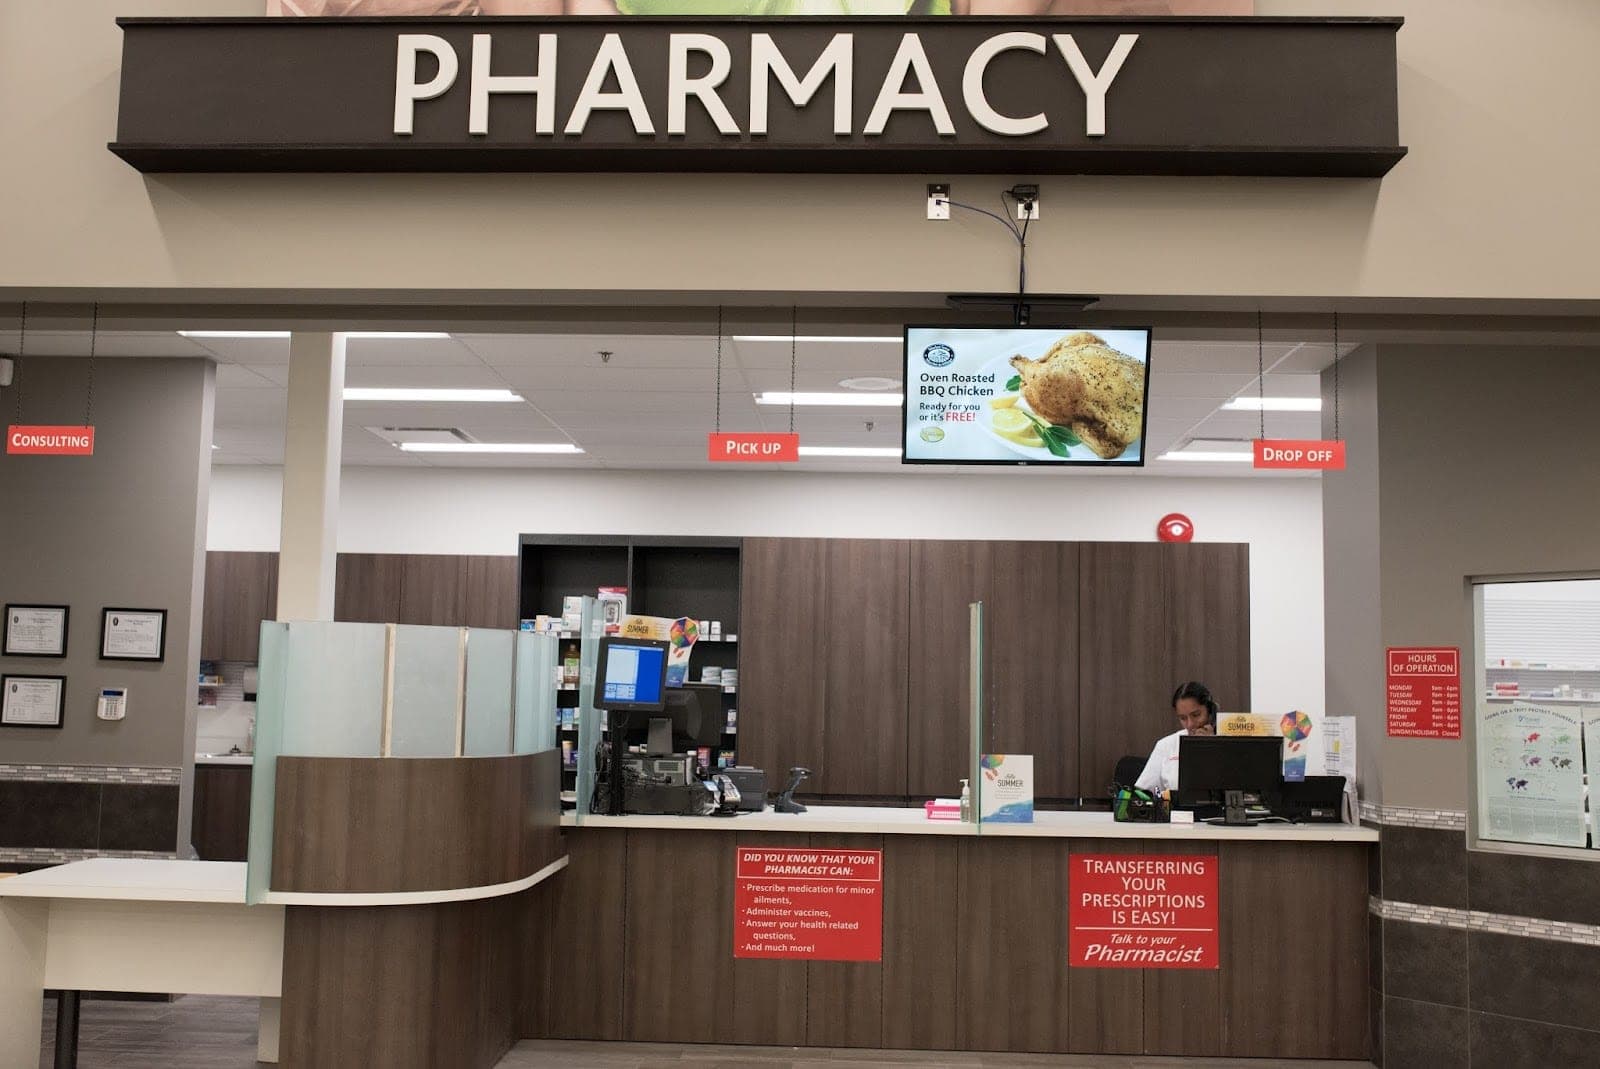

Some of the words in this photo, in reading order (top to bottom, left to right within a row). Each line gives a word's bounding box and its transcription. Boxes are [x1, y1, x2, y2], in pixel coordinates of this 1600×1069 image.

[393, 32, 1140, 136] PHARMACY
[920, 373, 948, 382] Oven
[951, 372, 995, 383] Roasted
[920, 385, 945, 397] BBQ
[948, 385, 994, 396] Chicken
[919, 402, 946, 412] Ready
[948, 402, 961, 410] for
[964, 403, 980, 412] you
[930, 413, 944, 421] it's
[945, 412, 976, 421] FREE!
[12, 433, 89, 447] CONSULTING
[726, 440, 758, 454] PICK
[762, 442, 781, 454] UP
[1263, 447, 1303, 461] DROP
[1307, 450, 1333, 462] OFF
[627, 624, 648, 635] SUMMER
[1408, 654, 1437, 663] HOURS
[1393, 664, 1404, 672] OF
[1406, 664, 1453, 673] OPERATION
[1227, 722, 1255, 731] SUMMER
[997, 779, 1024, 787] SUMMER
[743, 853, 761, 862] DID
[764, 853, 784, 862] YOU
[786, 854, 817, 863] KNOW
[820, 854, 846, 864] THAT
[848, 855, 875, 865] YOUR
[764, 866, 827, 875] PHARMACIST
[829, 866, 854, 876] CAN:
[1083, 859, 1205, 875] TRANSFERRING
[747, 883, 785, 892] Prescribe
[787, 884, 833, 893] medication
[836, 885, 848, 894] for
[850, 886, 875, 894] minor
[1121, 876, 1166, 891] YOUR
[753, 895, 792, 905] ailments,
[1082, 893, 1206, 909] PRESCRIPTIONS
[746, 908, 791, 916] Administer
[793, 909, 831, 918] vaccines,
[1112, 910, 1126, 924] IS
[1131, 910, 1176, 925] EASY!
[746, 919, 777, 927] Answer
[779, 922, 798, 930] your
[800, 920, 827, 929] health
[829, 921, 859, 930] related
[753, 931, 796, 941] questions,
[1110, 933, 1133, 944] Talk
[1136, 934, 1148, 944] to
[1150, 936, 1177, 949] your
[745, 943, 762, 951] And
[764, 943, 787, 951] much
[789, 944, 815, 953] more!
[1084, 944, 1204, 963] Pharmacist
